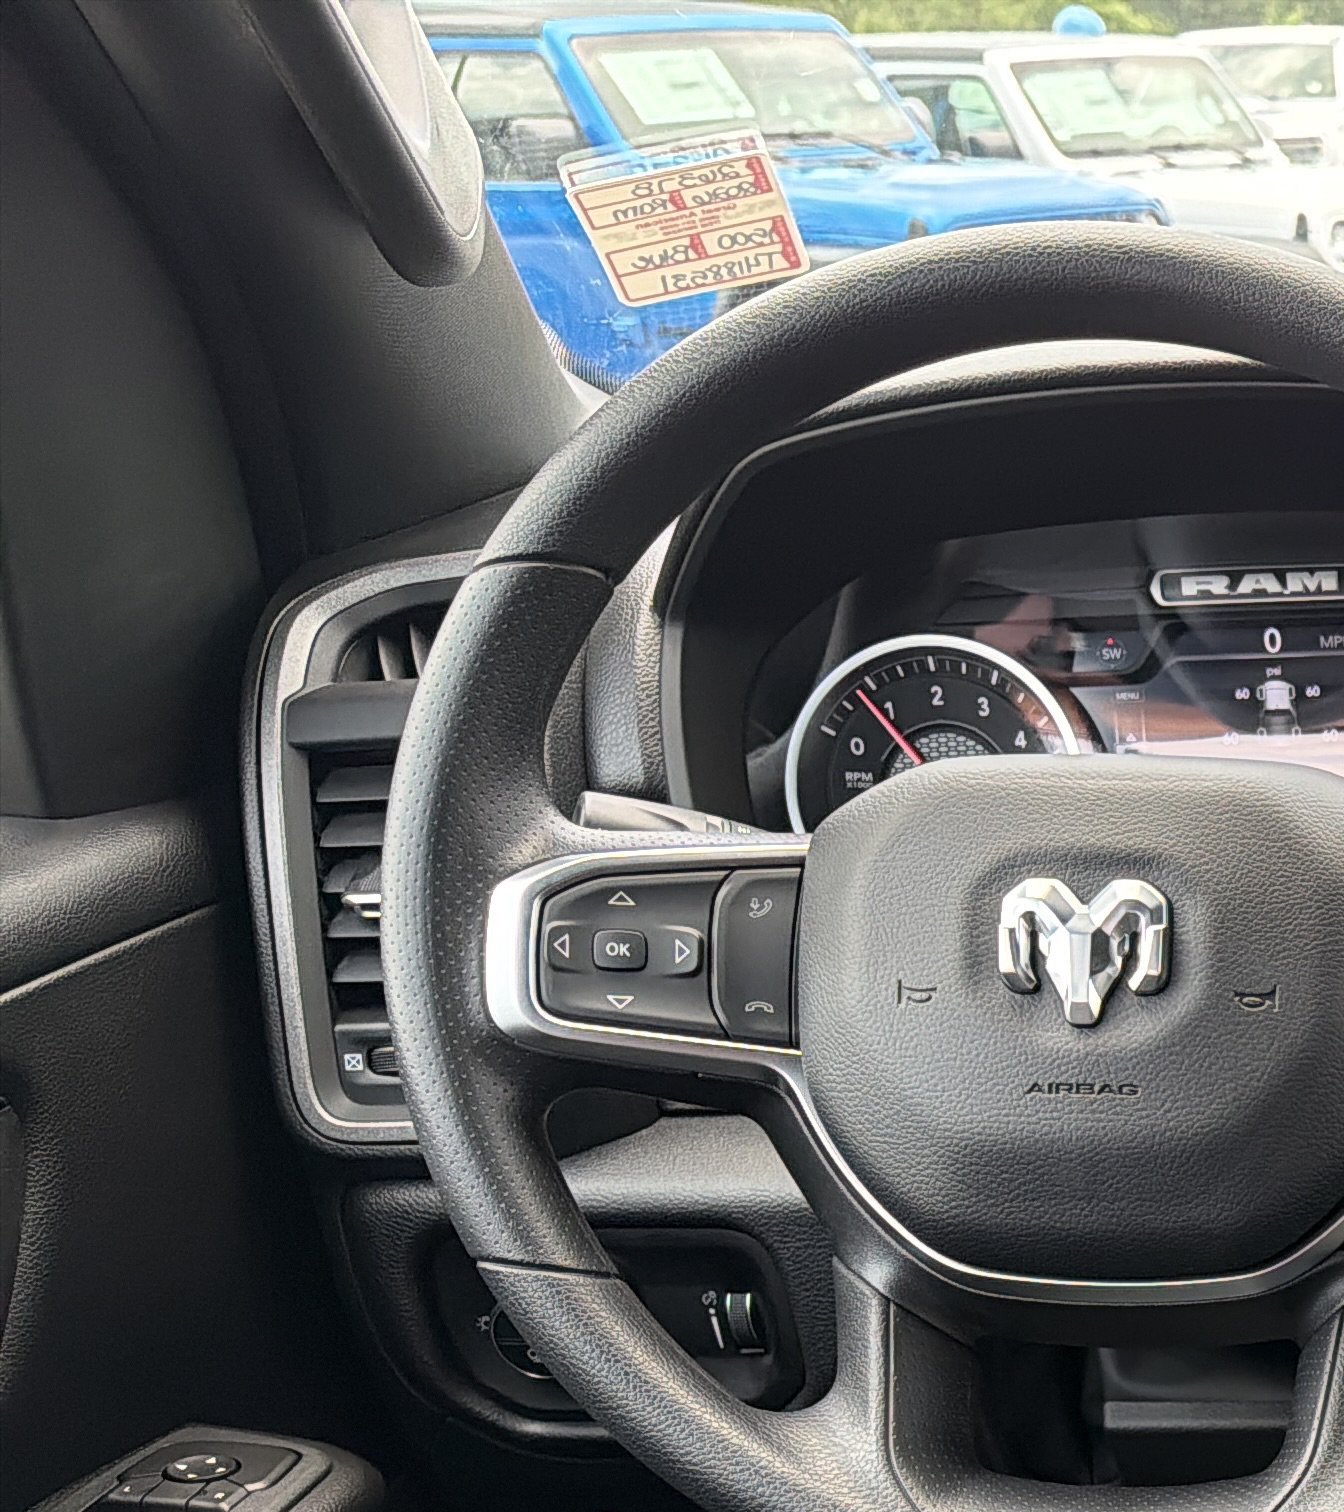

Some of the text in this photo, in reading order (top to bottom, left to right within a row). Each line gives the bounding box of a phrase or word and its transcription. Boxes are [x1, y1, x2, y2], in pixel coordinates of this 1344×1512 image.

[1180, 570, 1339, 597] RAM
[1263, 626, 1282, 654] 0
[1101, 646, 1122, 660] SW
[1265, 664, 1282, 678] psi
[930, 685, 945, 706] 2
[1115, 691, 1140, 701] MENU
[1234, 686, 1250, 700] 60
[1305, 685, 1321, 699] 60
[883, 700, 896, 721] 1
[977, 696, 990, 717] 3
[1014, 730, 1028, 749] 4
[1222, 732, 1240, 746] 60
[1322, 728, 1339, 742] 60
[850, 736, 865, 756] 0
[845, 771, 874, 782] RPM
[605, 942, 632, 957] OK
[1024, 1081, 1142, 1099] AIRBAG
